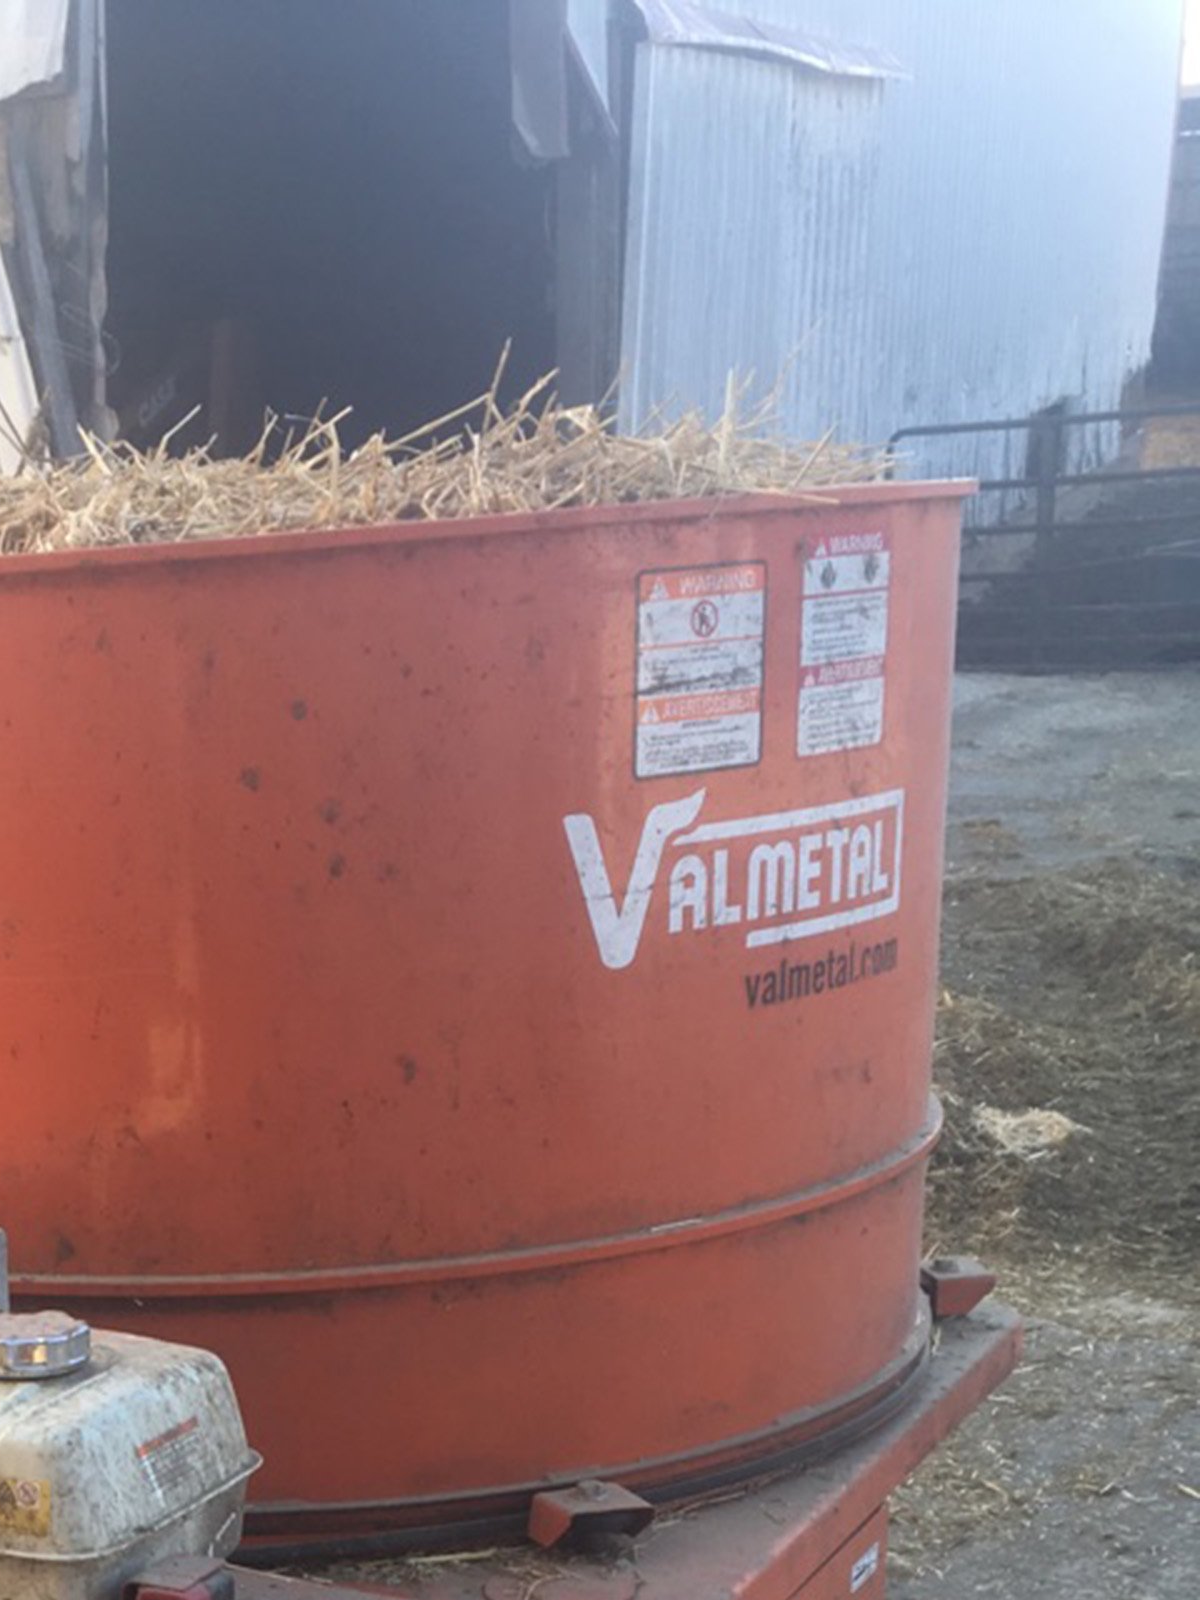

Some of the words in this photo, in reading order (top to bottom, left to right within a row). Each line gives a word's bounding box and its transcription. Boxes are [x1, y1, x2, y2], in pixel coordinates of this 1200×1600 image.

[679, 568, 757, 596] WARNING
[562, 787, 891, 969] VALMETAL
[745, 938, 898, 1009] valmetal.com
